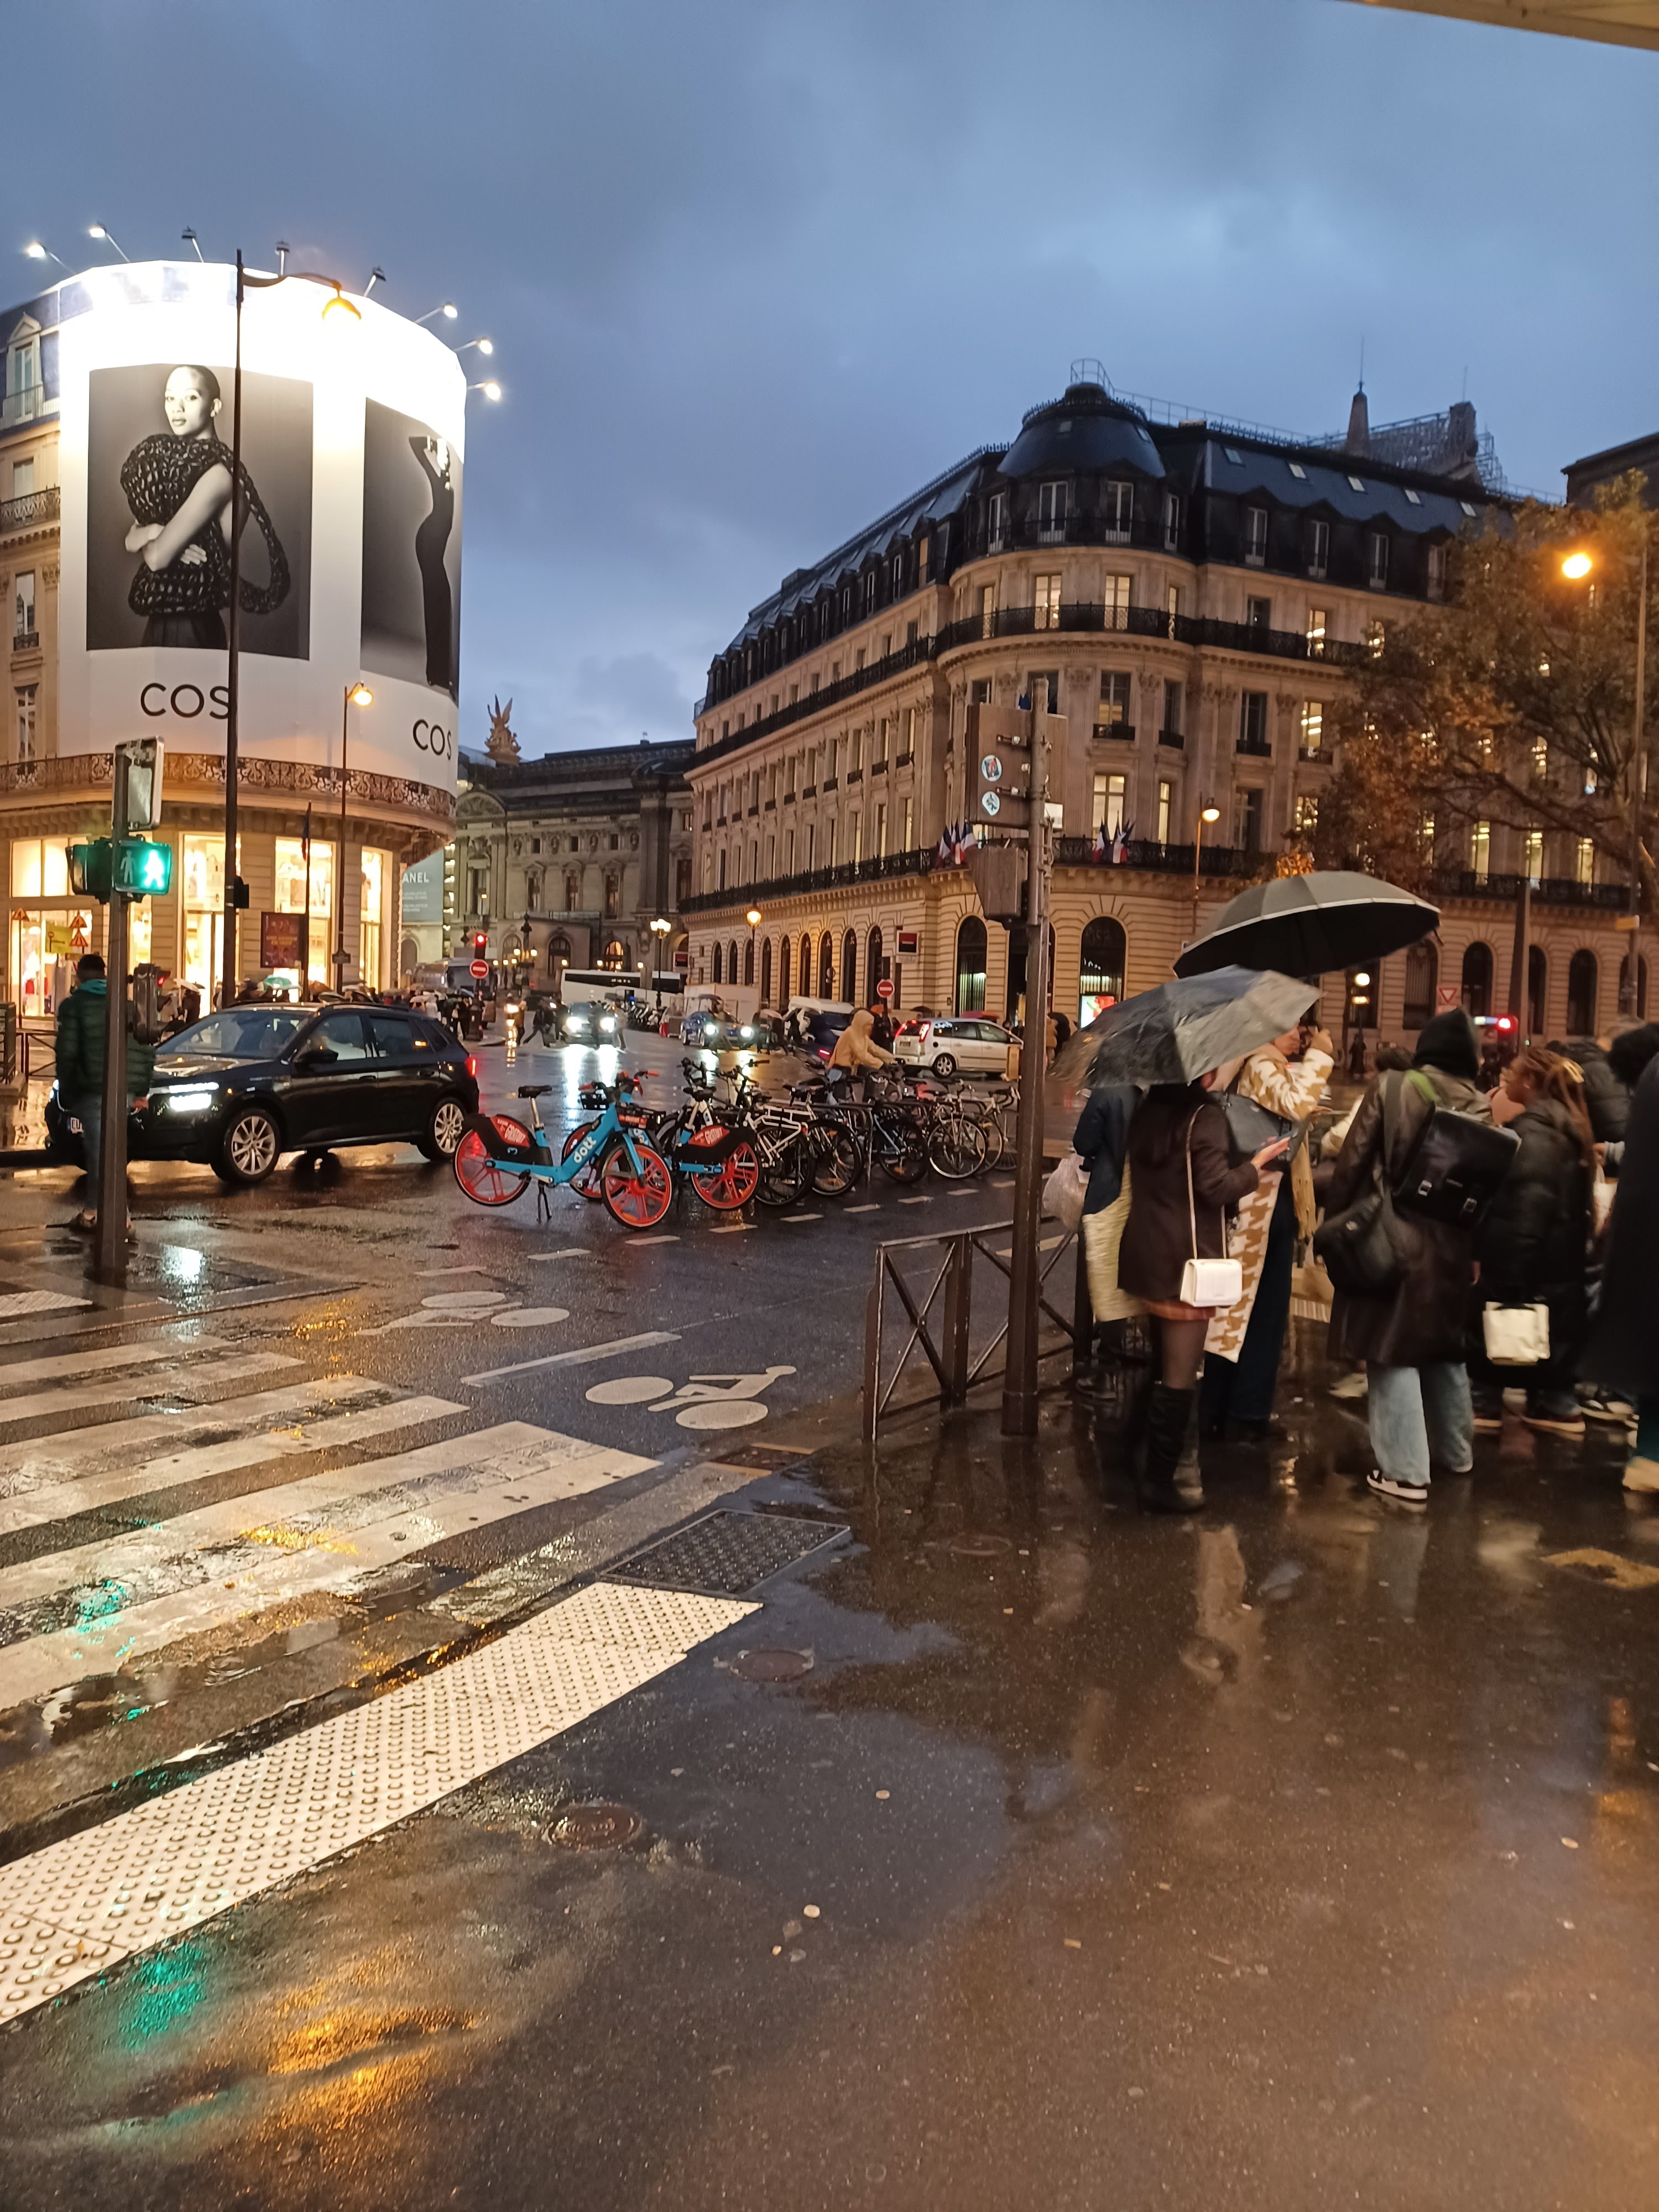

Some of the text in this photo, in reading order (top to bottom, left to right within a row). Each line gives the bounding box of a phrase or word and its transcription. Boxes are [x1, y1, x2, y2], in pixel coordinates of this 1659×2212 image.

[140, 682, 229, 719] COS
[413, 719, 452, 760] COS
[573, 1136, 597, 1163] dott
